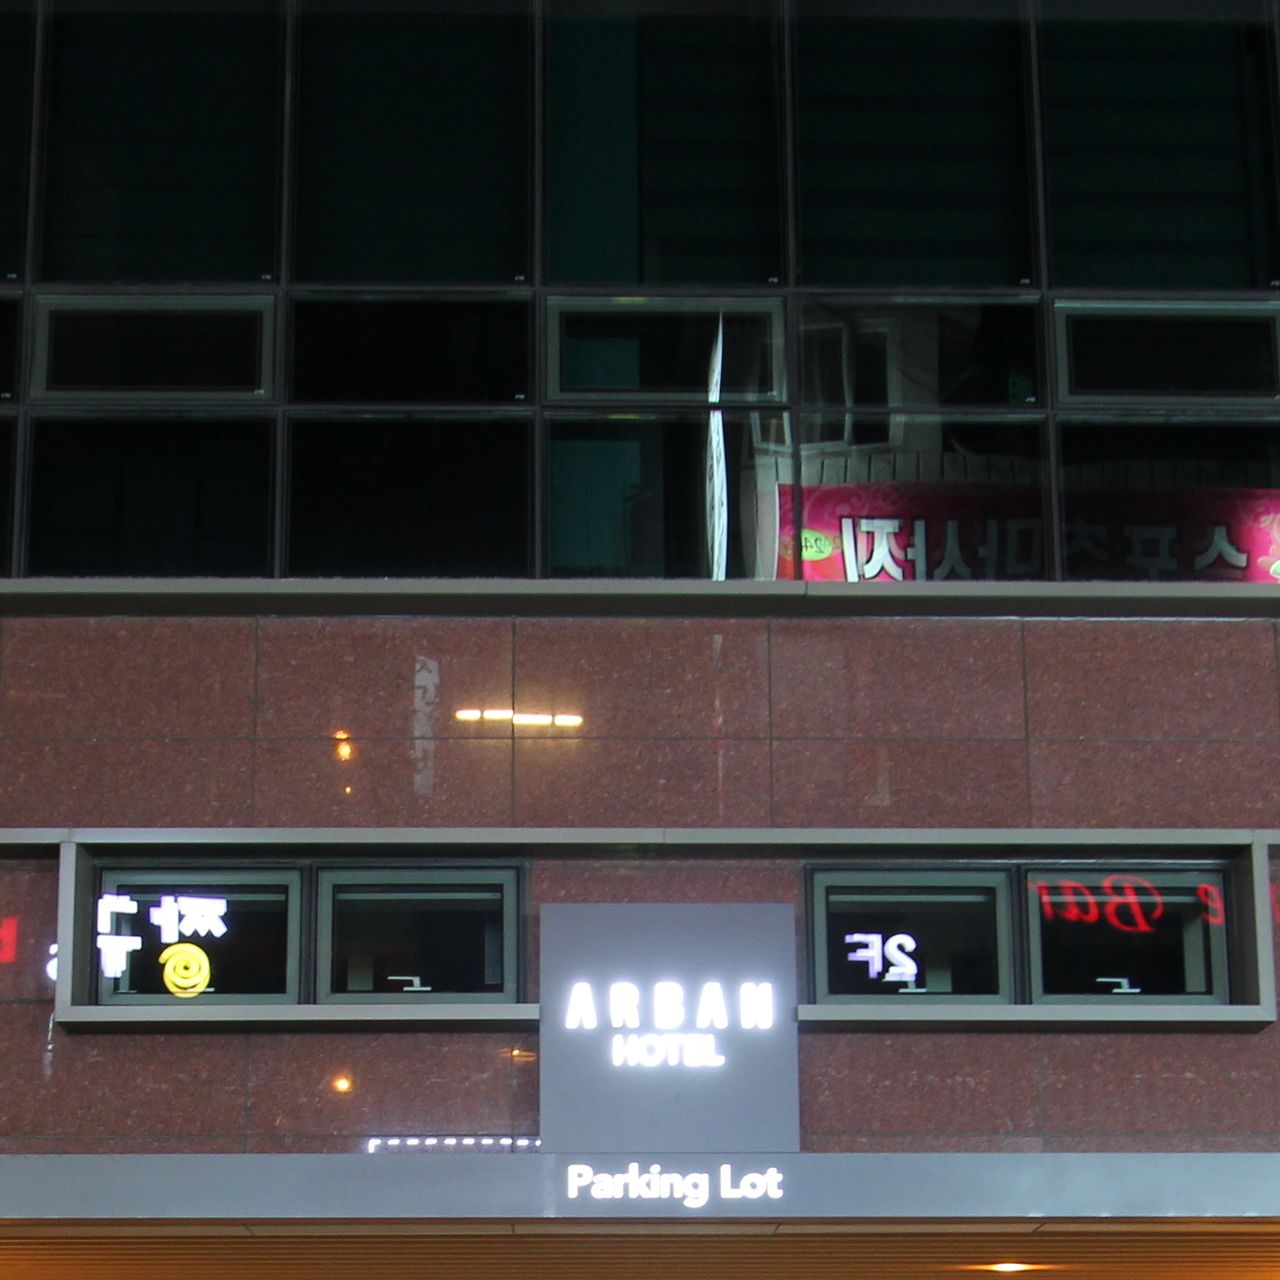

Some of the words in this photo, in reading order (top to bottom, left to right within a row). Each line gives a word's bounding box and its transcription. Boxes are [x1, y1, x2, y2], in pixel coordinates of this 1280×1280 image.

[564, 982, 775, 1031] ARBAN
[611, 1033, 725, 1068] HOTEL
[567, 1164, 710, 1209] Parking
[720, 1164, 784, 1201] Lot
